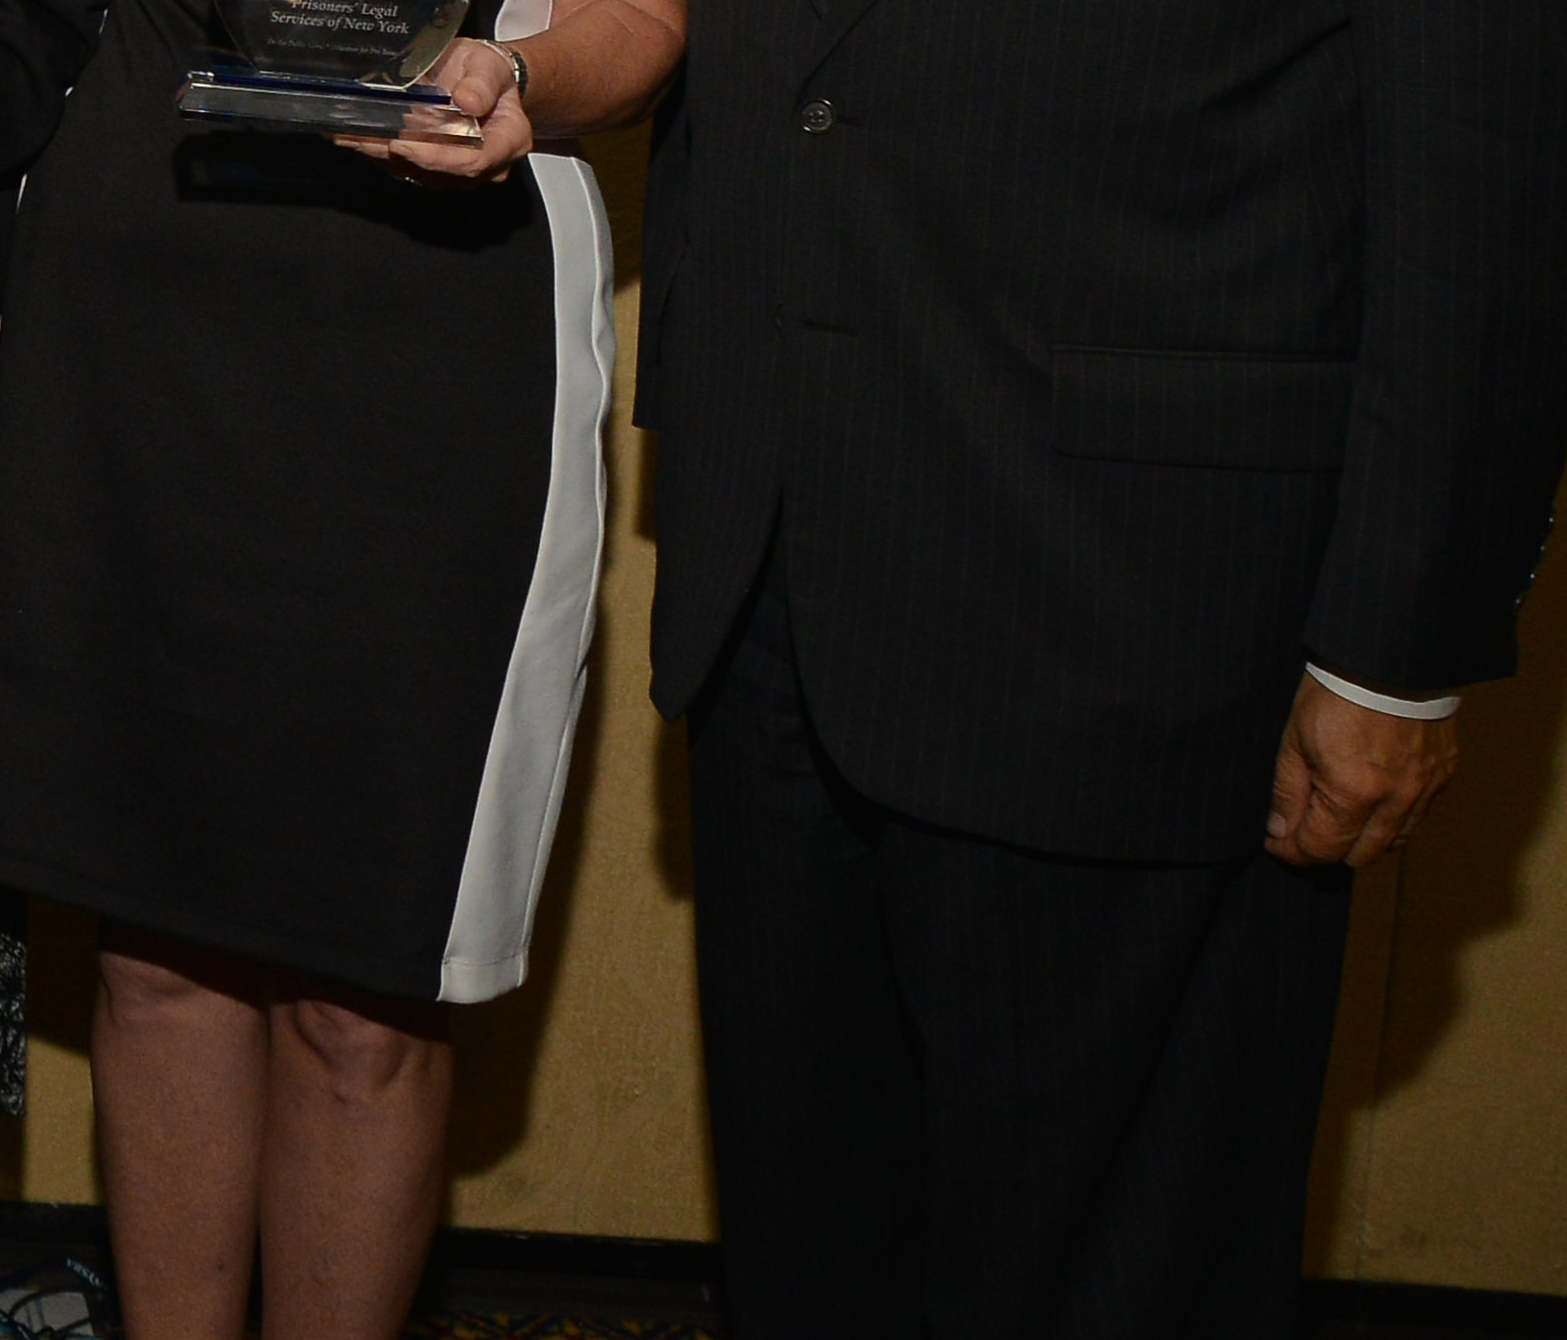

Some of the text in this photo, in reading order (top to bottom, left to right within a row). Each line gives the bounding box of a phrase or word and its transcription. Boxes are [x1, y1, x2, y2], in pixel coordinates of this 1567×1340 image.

[361, 2, 399, 19] Legal
[271, 10, 410, 34] Services of New York
